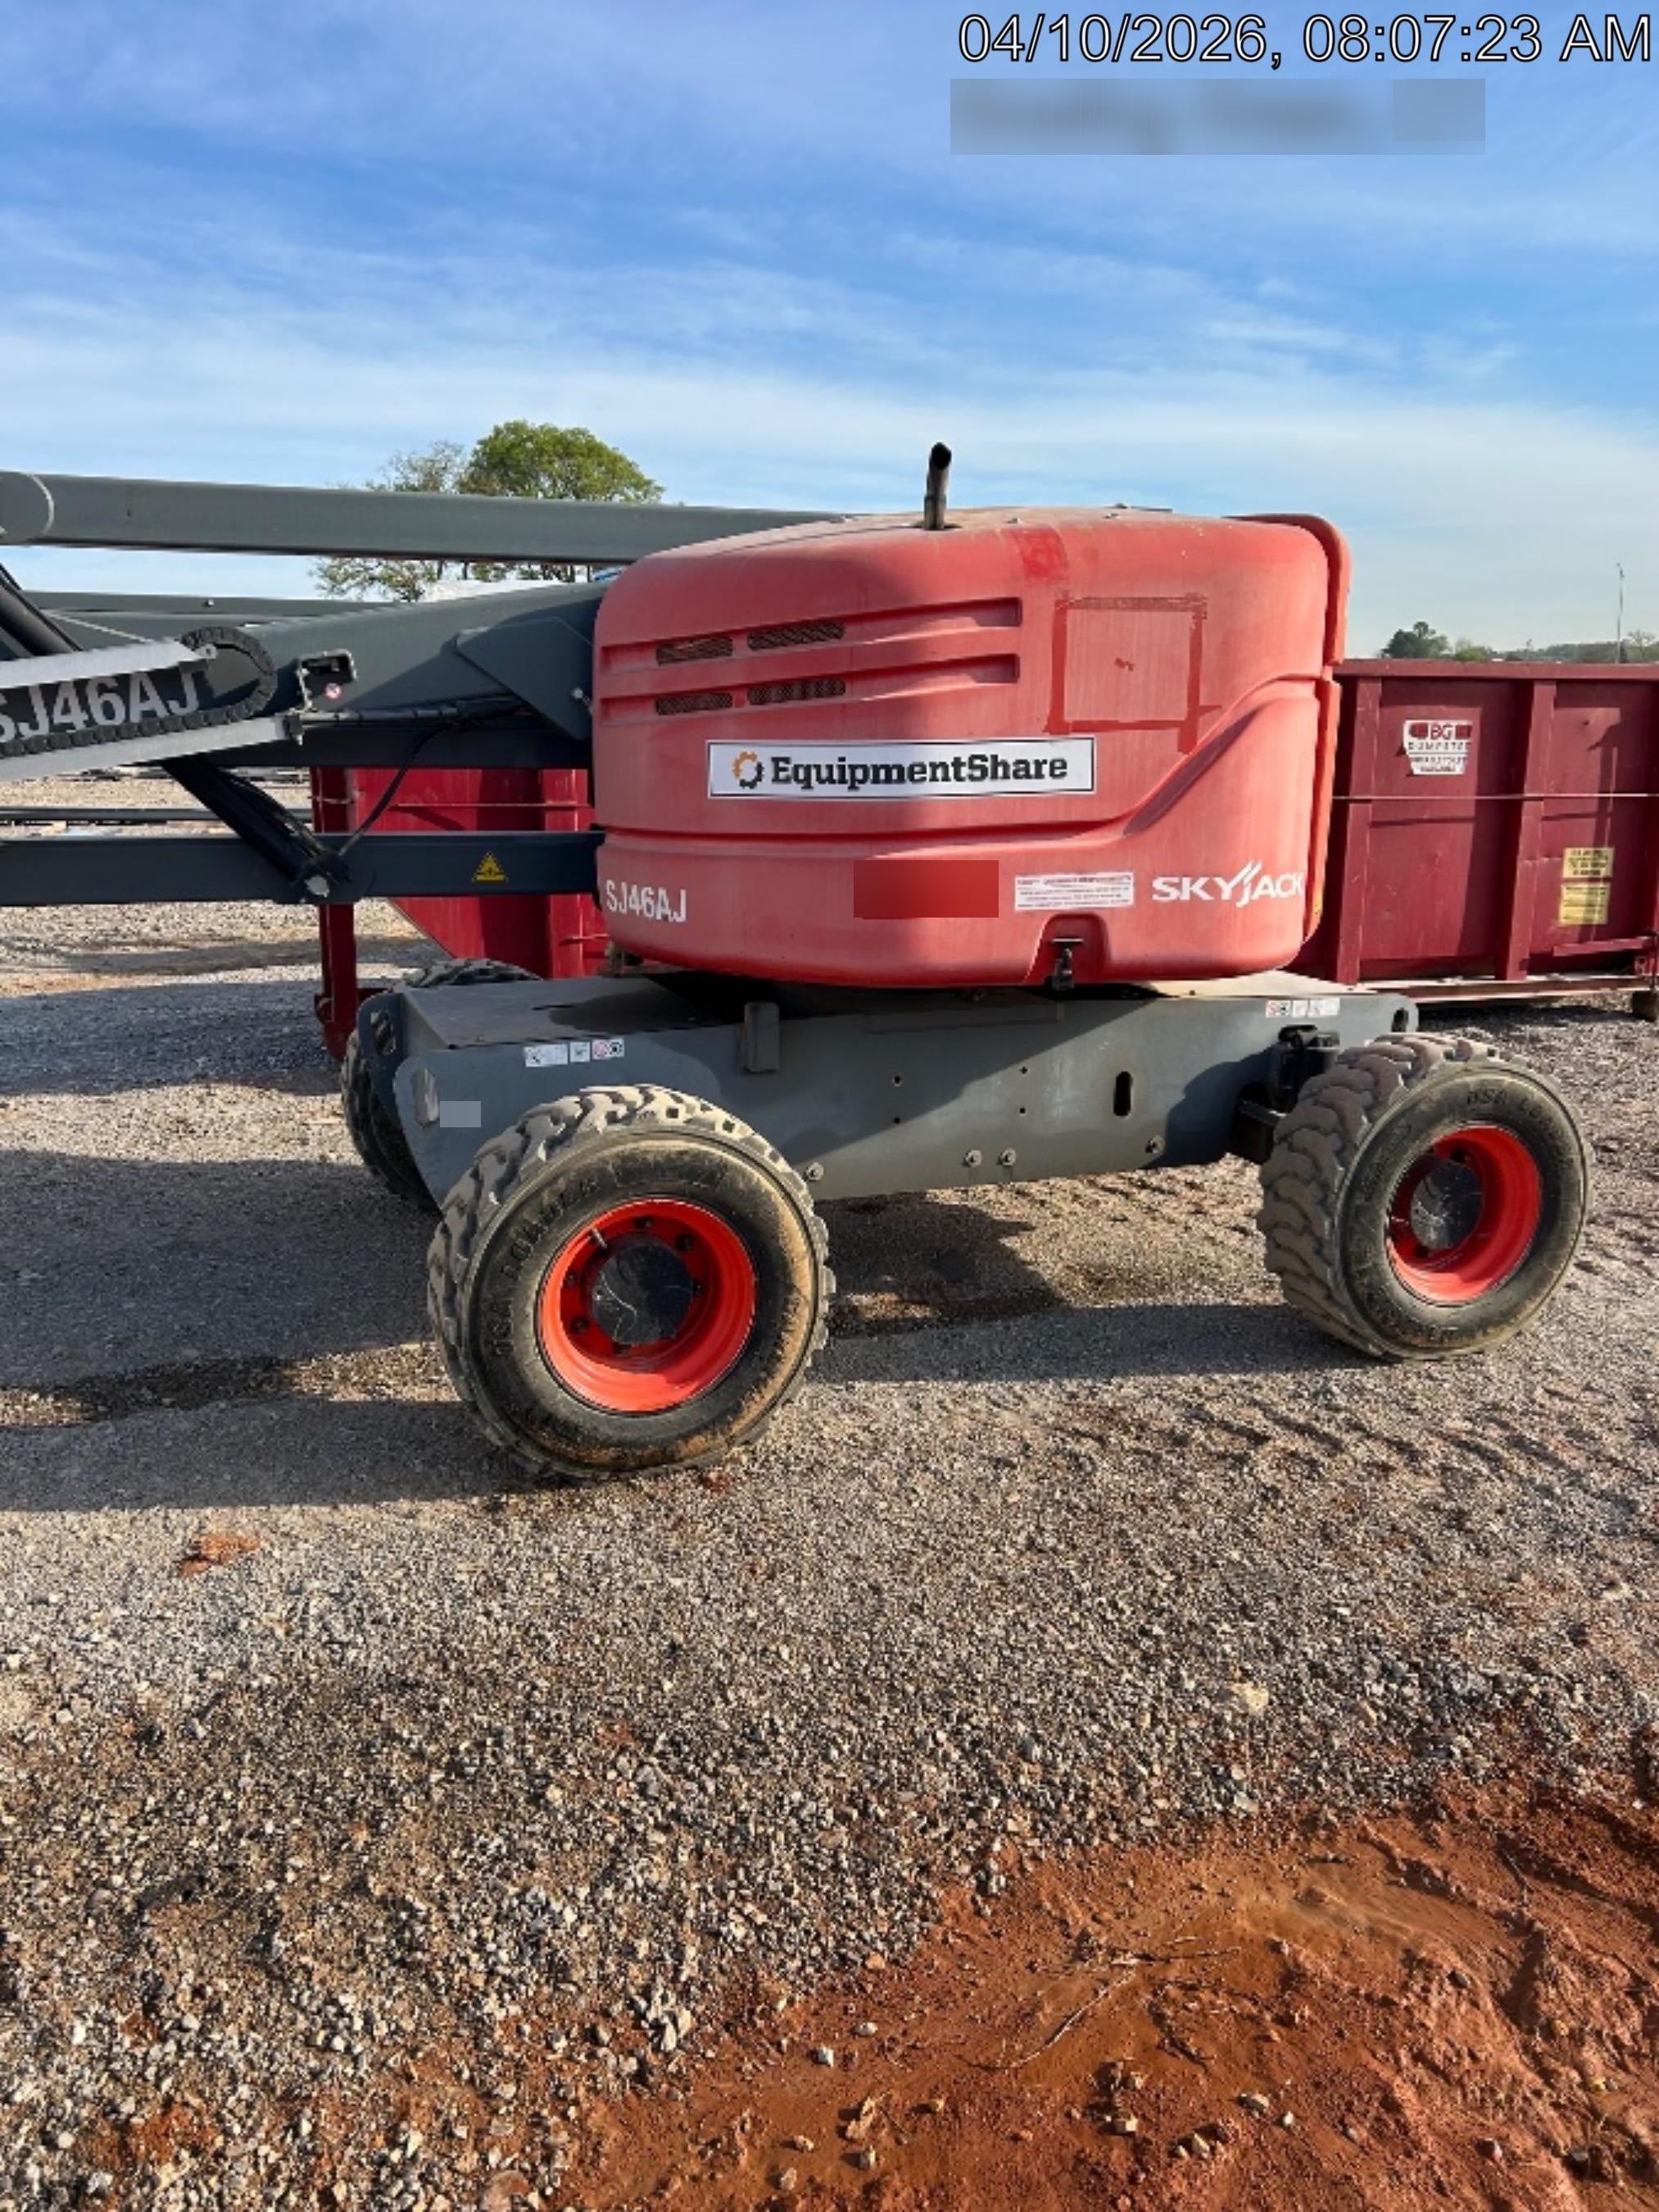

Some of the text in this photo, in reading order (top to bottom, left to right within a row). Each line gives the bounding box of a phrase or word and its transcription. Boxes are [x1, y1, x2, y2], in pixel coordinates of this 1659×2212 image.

[770, 754, 1067, 791] EquipmentShare
[606, 879, 687, 922] SJ46AJ
[1152, 861, 1304, 908] SKYJACK
